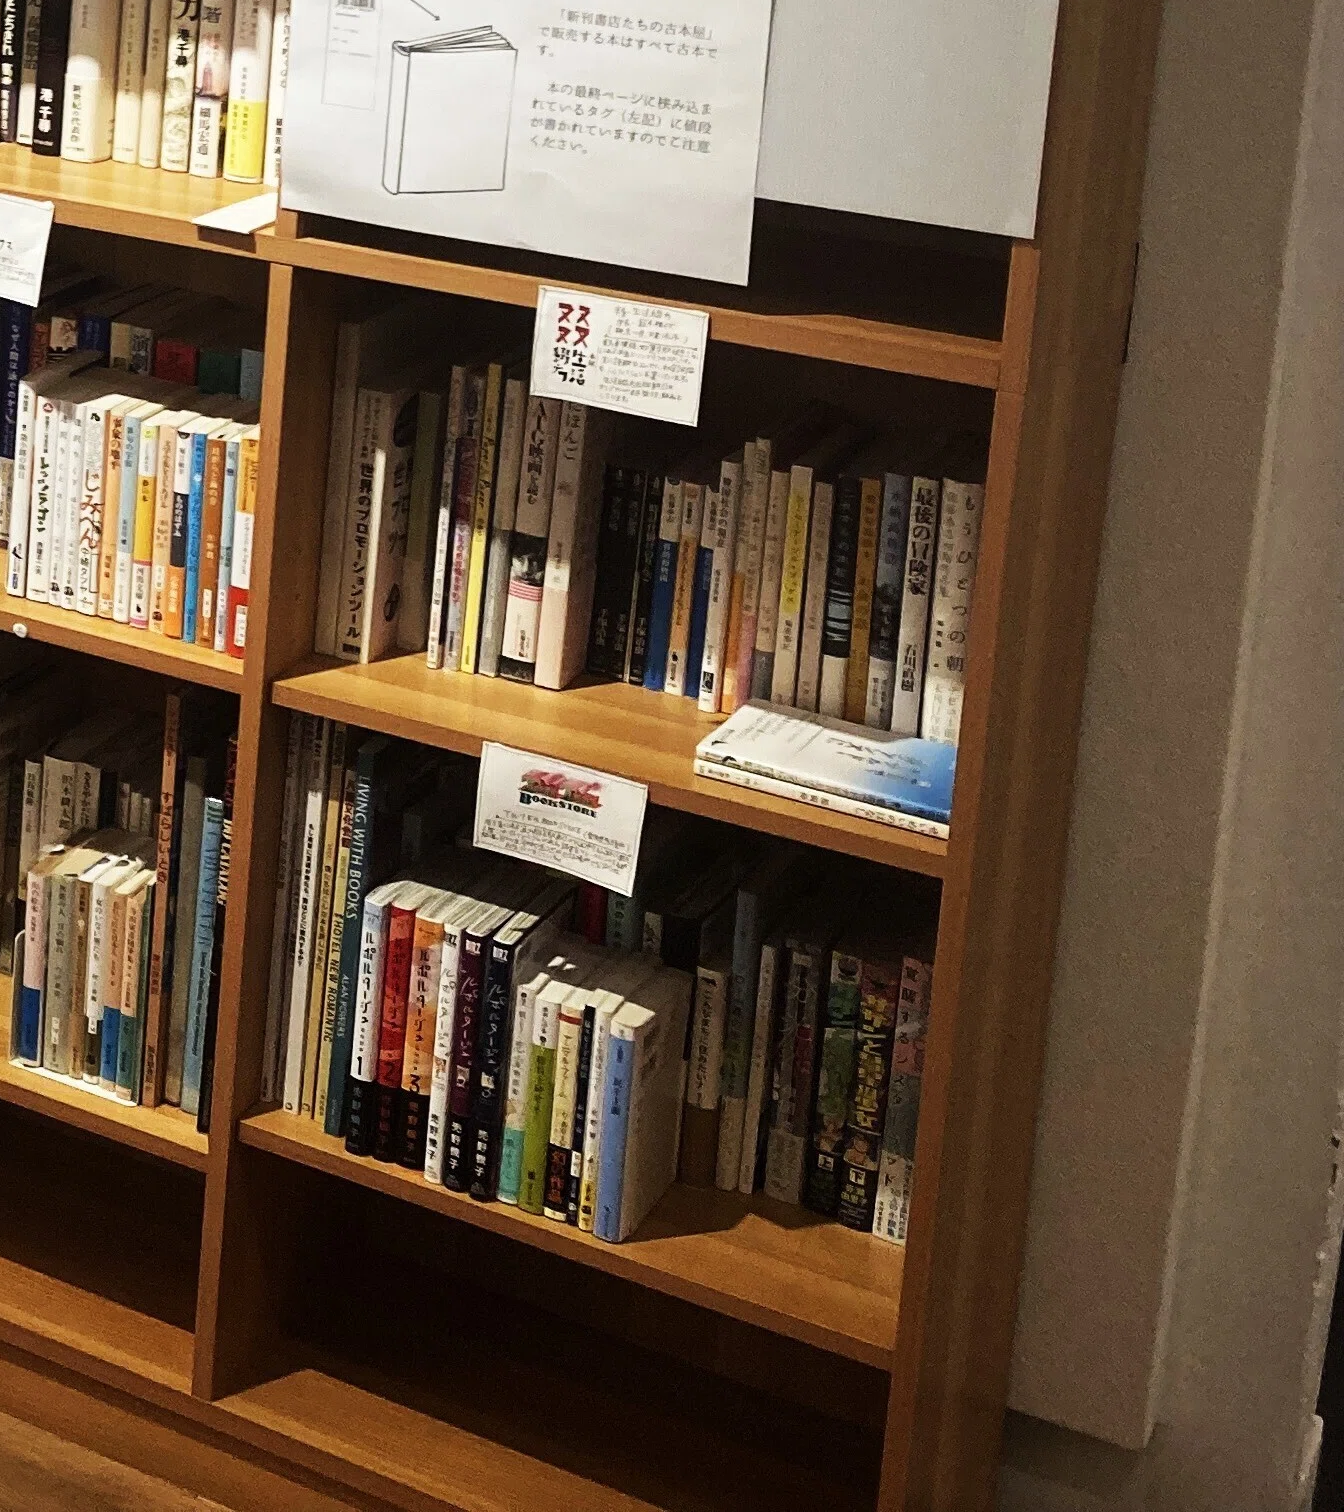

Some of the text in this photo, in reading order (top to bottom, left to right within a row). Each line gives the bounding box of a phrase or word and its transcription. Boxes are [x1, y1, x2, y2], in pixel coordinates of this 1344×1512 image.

[538, 25, 718, 59] で販売する本はすべて古本で
[530, 135, 588, 154] ください。
[909, 486, 938, 597] 最後の冒険家
[946, 492, 976, 675] もうひとつの朝
[345, 776, 371, 921] LIVING WITH BOOKS
